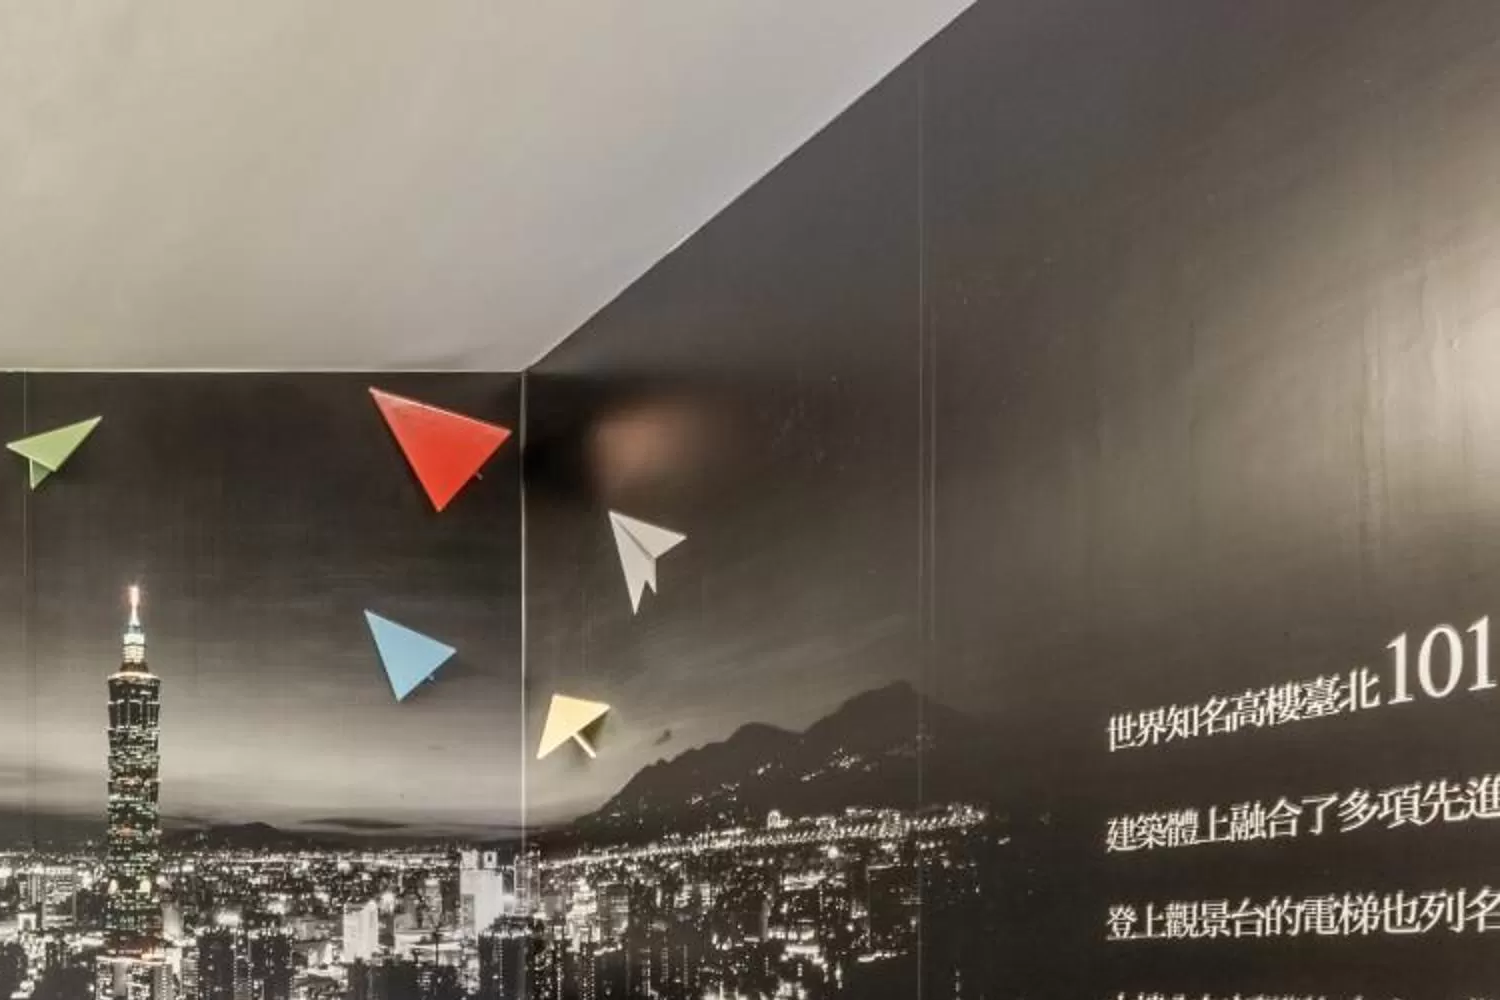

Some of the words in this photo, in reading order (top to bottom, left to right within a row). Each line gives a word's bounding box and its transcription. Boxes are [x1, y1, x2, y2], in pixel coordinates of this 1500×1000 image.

[1106, 773, 1500, 853] 建築體上融合了多項先進
[1106, 885, 1500, 941] 登上觀景台的電梯也列名
